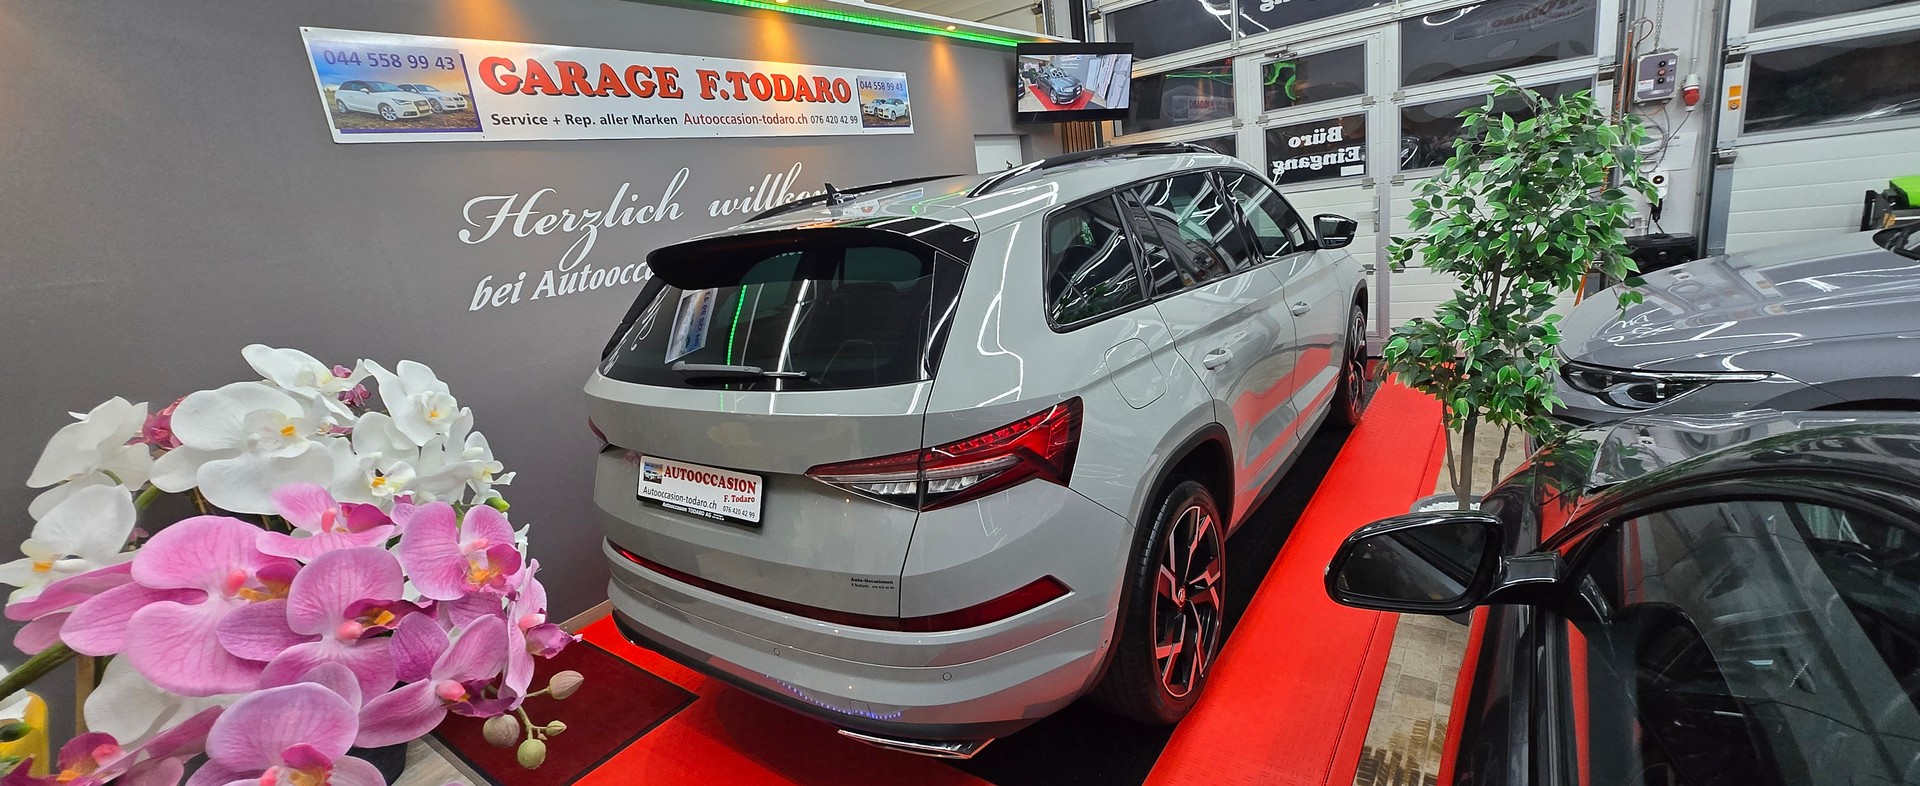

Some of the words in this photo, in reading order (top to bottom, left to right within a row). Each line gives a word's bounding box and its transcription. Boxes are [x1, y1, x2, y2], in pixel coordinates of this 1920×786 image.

[323, 49, 362, 66] 044
[367, 52, 402, 68] 558
[407, 54, 429, 70] 99
[435, 56, 456, 71] 43
[478, 56, 684, 100] GARAGE
[860, 80, 873, 91] 044
[873, 81, 886, 91] 558
[886, 82, 895, 92] 99
[895, 83, 904, 92] 43
[491, 113, 548, 126] Service
[564, 114, 596, 128] Rep.
[600, 114, 629, 125] aller
[632, 114, 678, 125] Marken
[683, 112, 808, 125] Autooccasion-todaro.ch
[810, 115, 824, 125] 076
[825, 115, 839, 125] 420
[838, 115, 849, 125] 42
[849, 114, 859, 125] 99
[458, 167, 690, 272] Herzlich
[469, 271, 527, 312] bei
[663, 465, 757, 495] AUTOOCCASION
[642, 486, 718, 510] Autooccasion-todaro.ch
[723, 494, 730, 503] F.
[731, 494, 756, 503] Todaro
[722, 505, 732, 513] 076
[732, 507, 741, 516] 420
[741, 509, 749, 517] 42
[749, 511, 756, 519] 99
